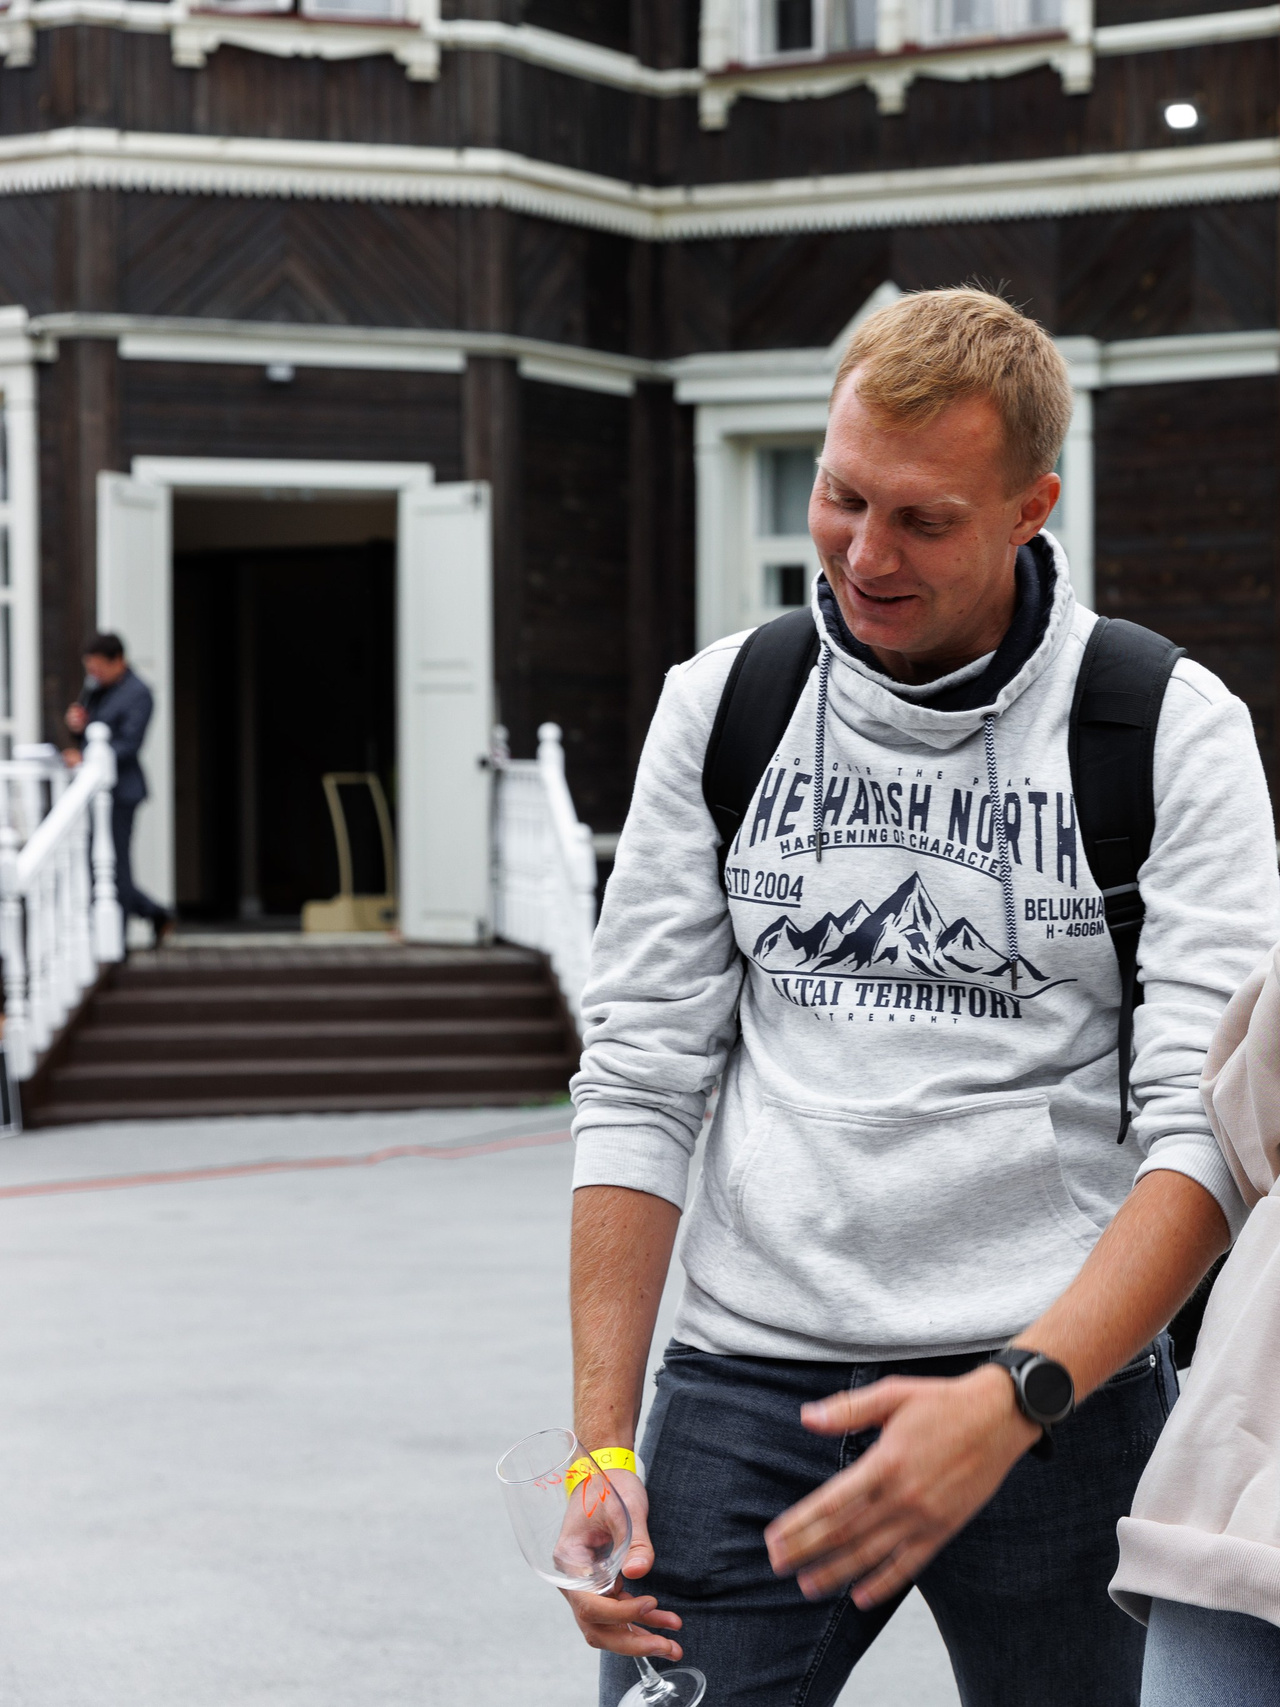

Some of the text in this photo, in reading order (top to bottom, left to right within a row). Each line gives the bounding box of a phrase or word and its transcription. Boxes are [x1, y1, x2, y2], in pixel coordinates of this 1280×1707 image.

[774, 753, 1032, 788] COQR THE PAK
[734, 767, 1078, 891] HE HARSH NORTH
[780, 828, 1010, 875] HARDENING OF CHARACTE
[754, 870, 804, 902] 2004
[1024, 896, 1104, 921] BELUKHA
[1066, 920, 1105, 938] 4506M
[855, 982, 1023, 1019] TERRITORY
